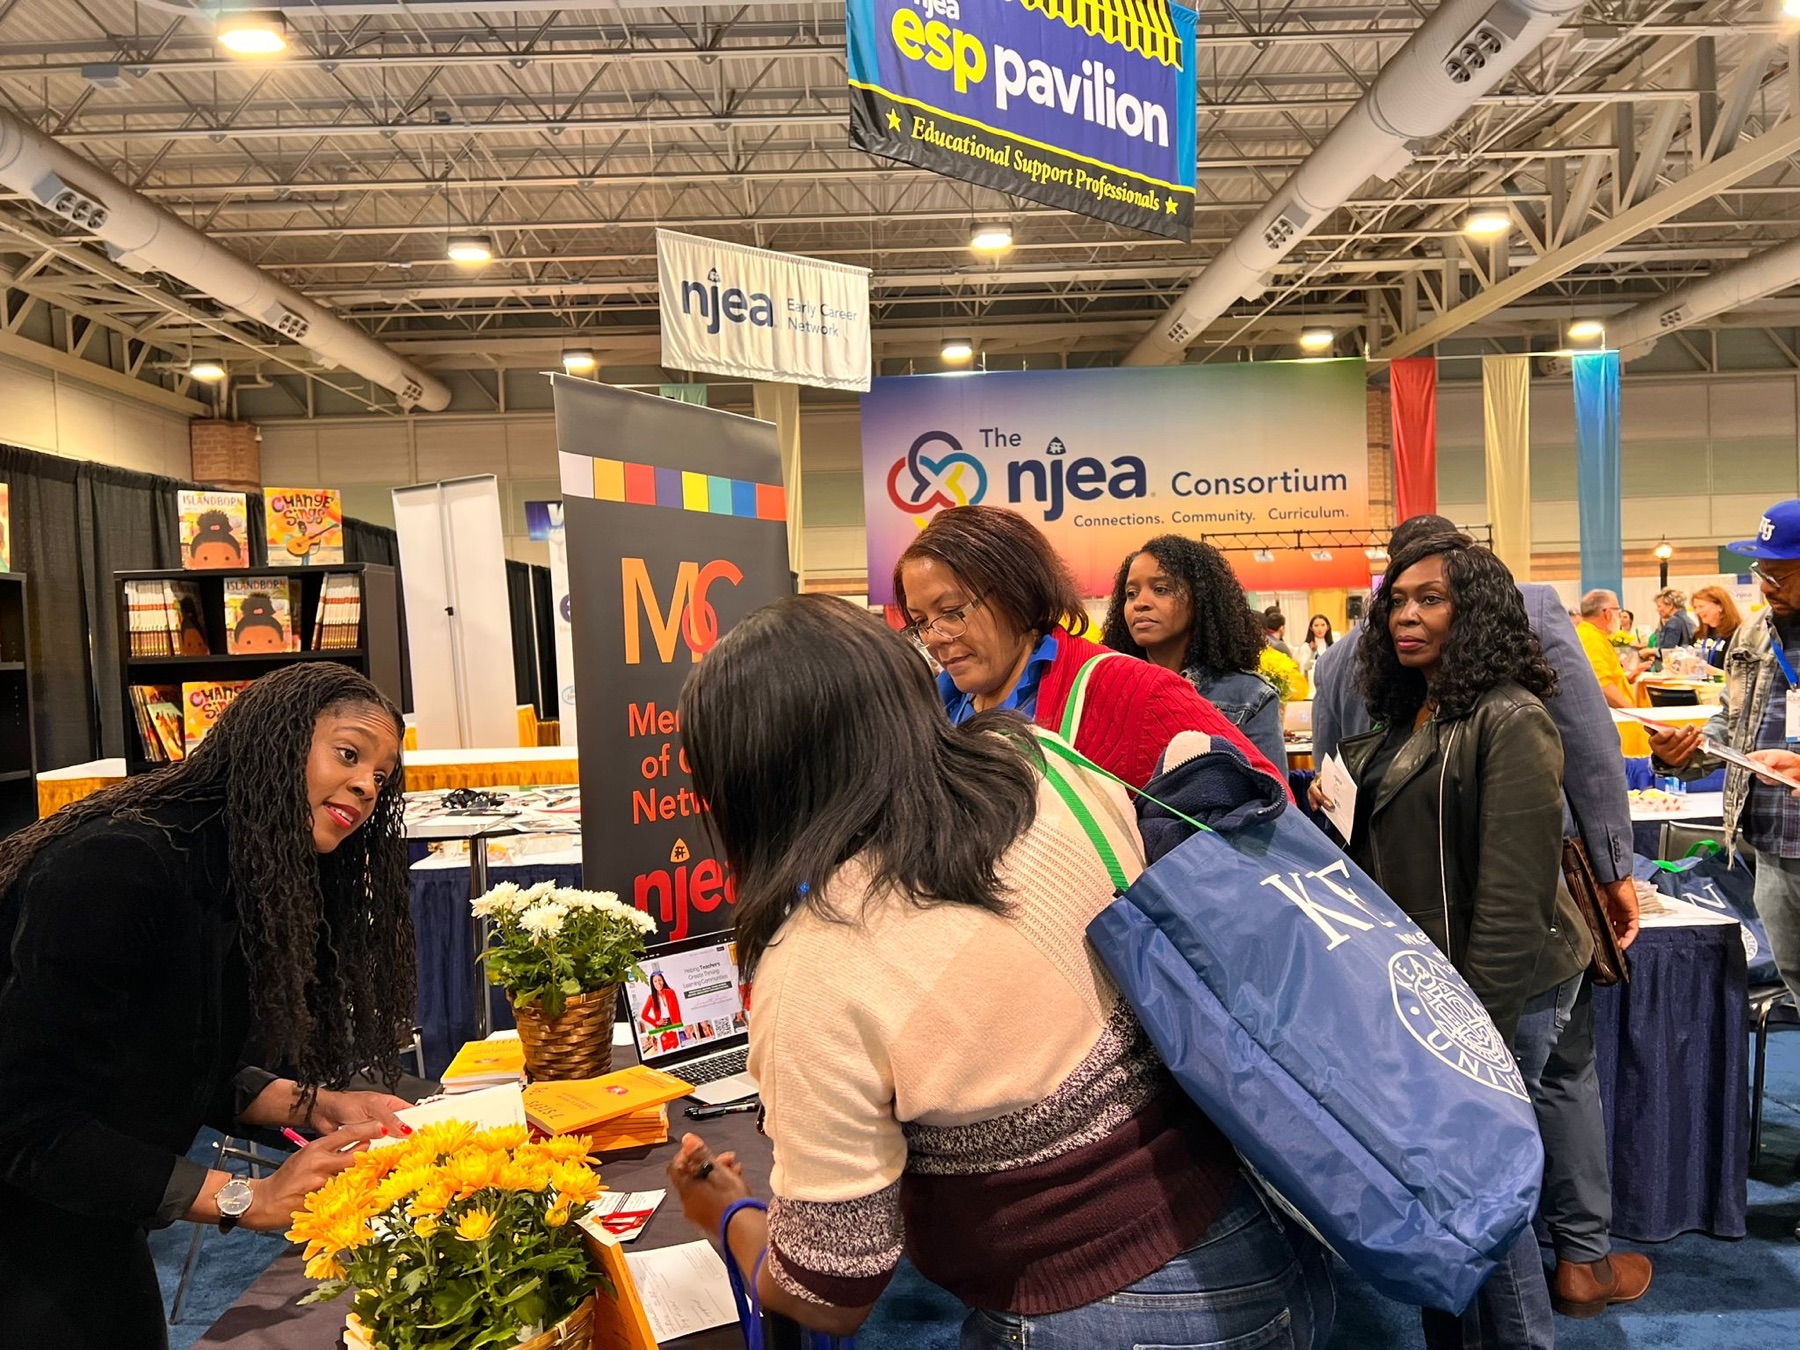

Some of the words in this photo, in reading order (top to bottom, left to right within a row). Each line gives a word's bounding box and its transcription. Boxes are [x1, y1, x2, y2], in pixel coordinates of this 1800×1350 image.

[892, 8, 987, 93] esp
[994, 44, 1169, 147] pavilion
[911, 116, 1010, 168] Educational
[1014, 149, 1073, 186] Support
[1076, 168, 1160, 211] Professionals
[681, 267, 774, 334] njea
[787, 297, 816, 318] Early
[820, 303, 857, 321] Career
[788, 316, 838, 336] Network
[979, 428, 1022, 448] The
[1007, 437, 1147, 522] njea
[1171, 468, 1348, 497] Consortium
[183, 495, 243, 506] ISLANDBORN
[1073, 513, 1165, 527] Connections.
[1171, 510, 1256, 525] Community.
[1268, 506, 1349, 521] Curriculum.
[226, 578, 286, 591] ISLANDBORN
[641, 743, 670, 779] of
